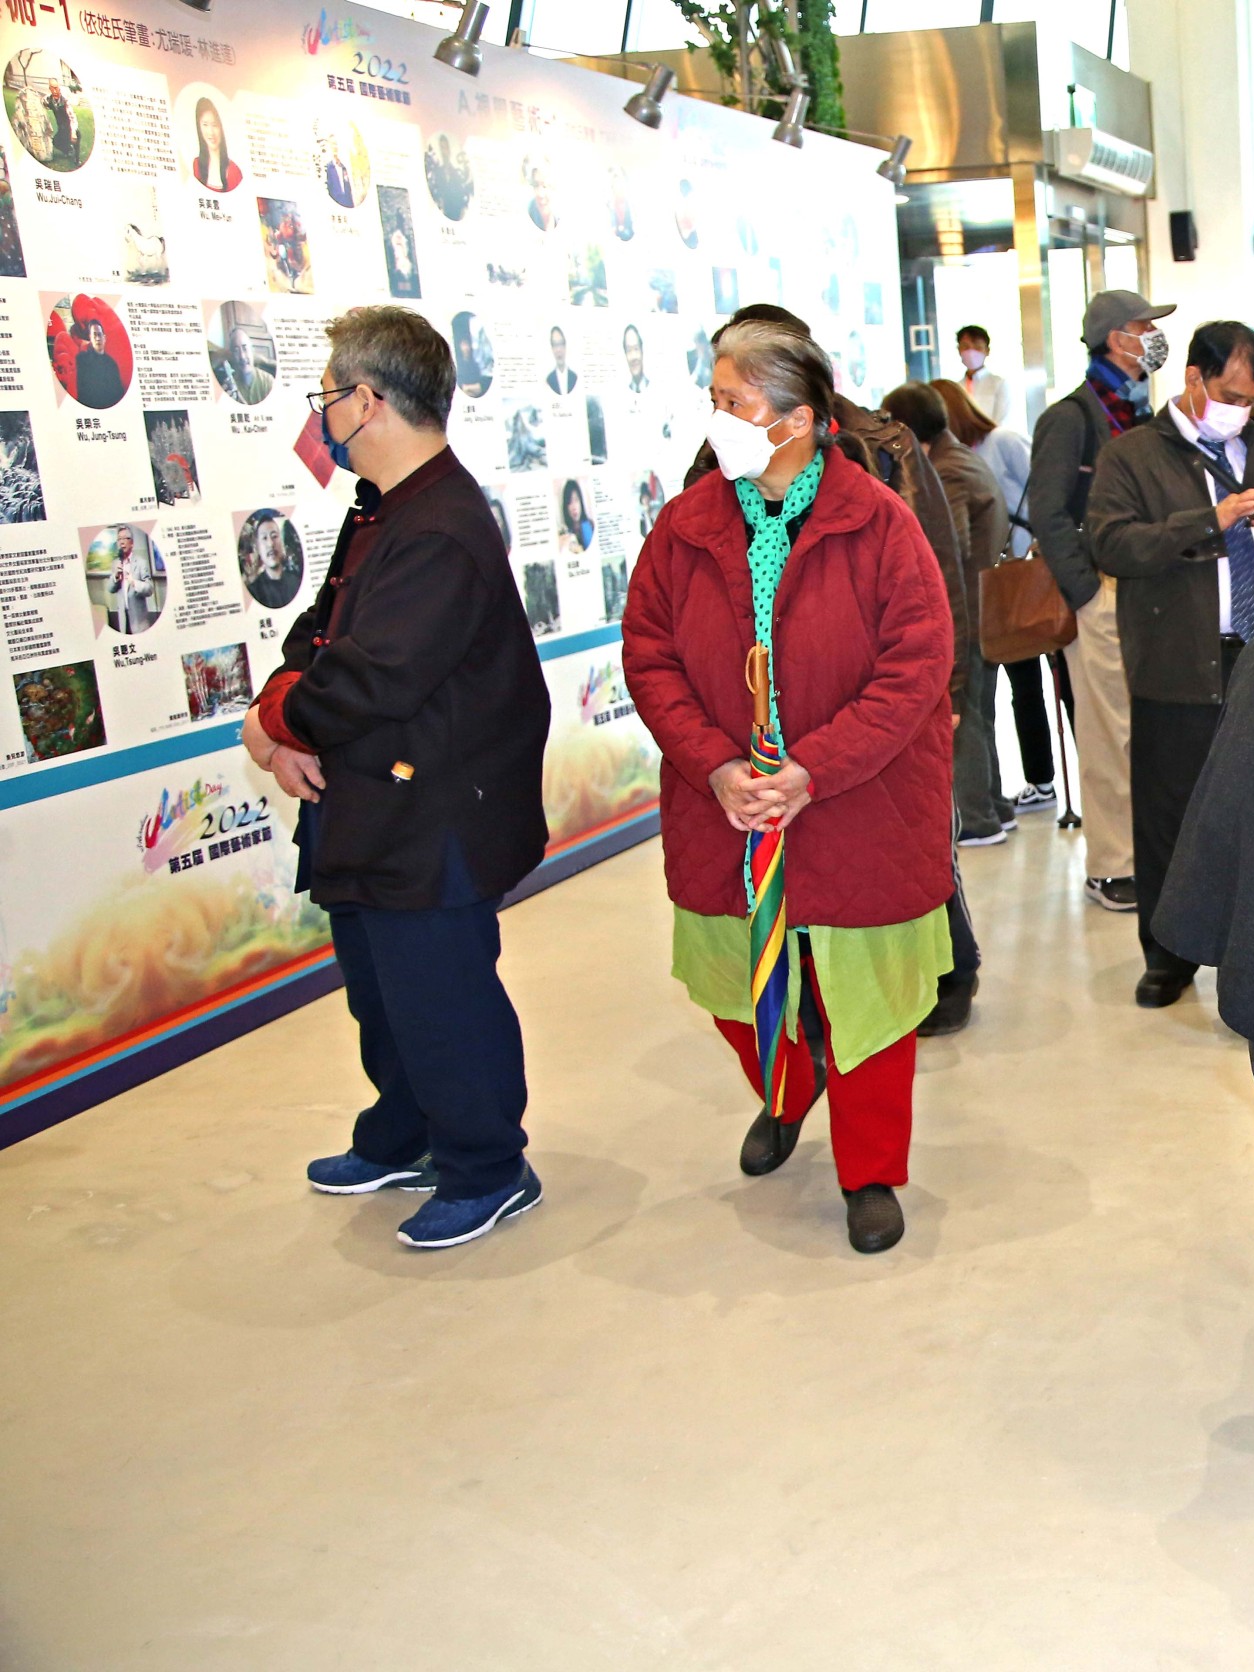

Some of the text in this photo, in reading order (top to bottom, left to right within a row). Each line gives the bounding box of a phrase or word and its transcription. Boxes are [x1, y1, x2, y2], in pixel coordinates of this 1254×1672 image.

[351, 51, 410, 85] 2022
[200, 795, 271, 840] 2022
[168, 848, 204, 875] 第五屆
